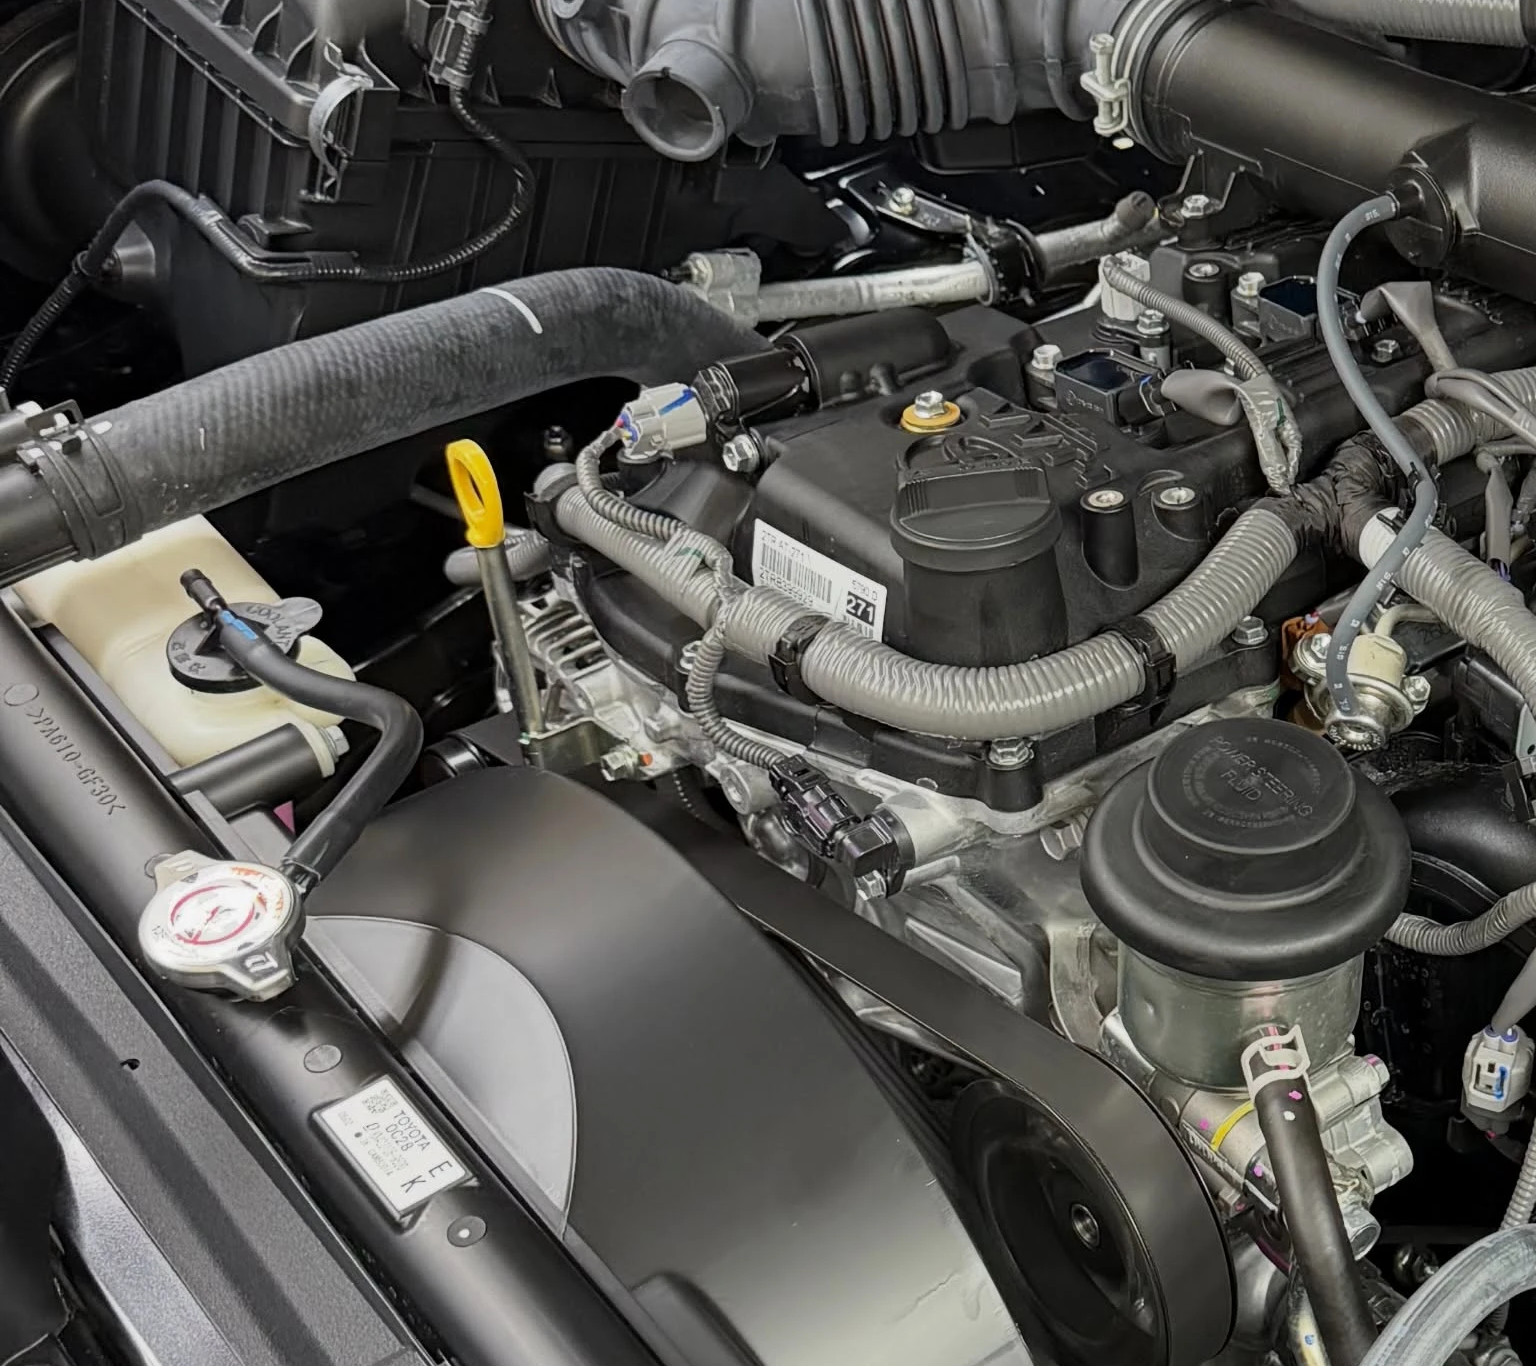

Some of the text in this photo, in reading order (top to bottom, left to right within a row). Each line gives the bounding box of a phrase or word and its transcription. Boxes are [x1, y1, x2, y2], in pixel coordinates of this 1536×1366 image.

[846, 592, 874, 624] 271
[1219, 766, 1262, 803] FLUID
[393, 1109, 453, 1178] TOYOTA E
[400, 1174, 427, 1194] K
